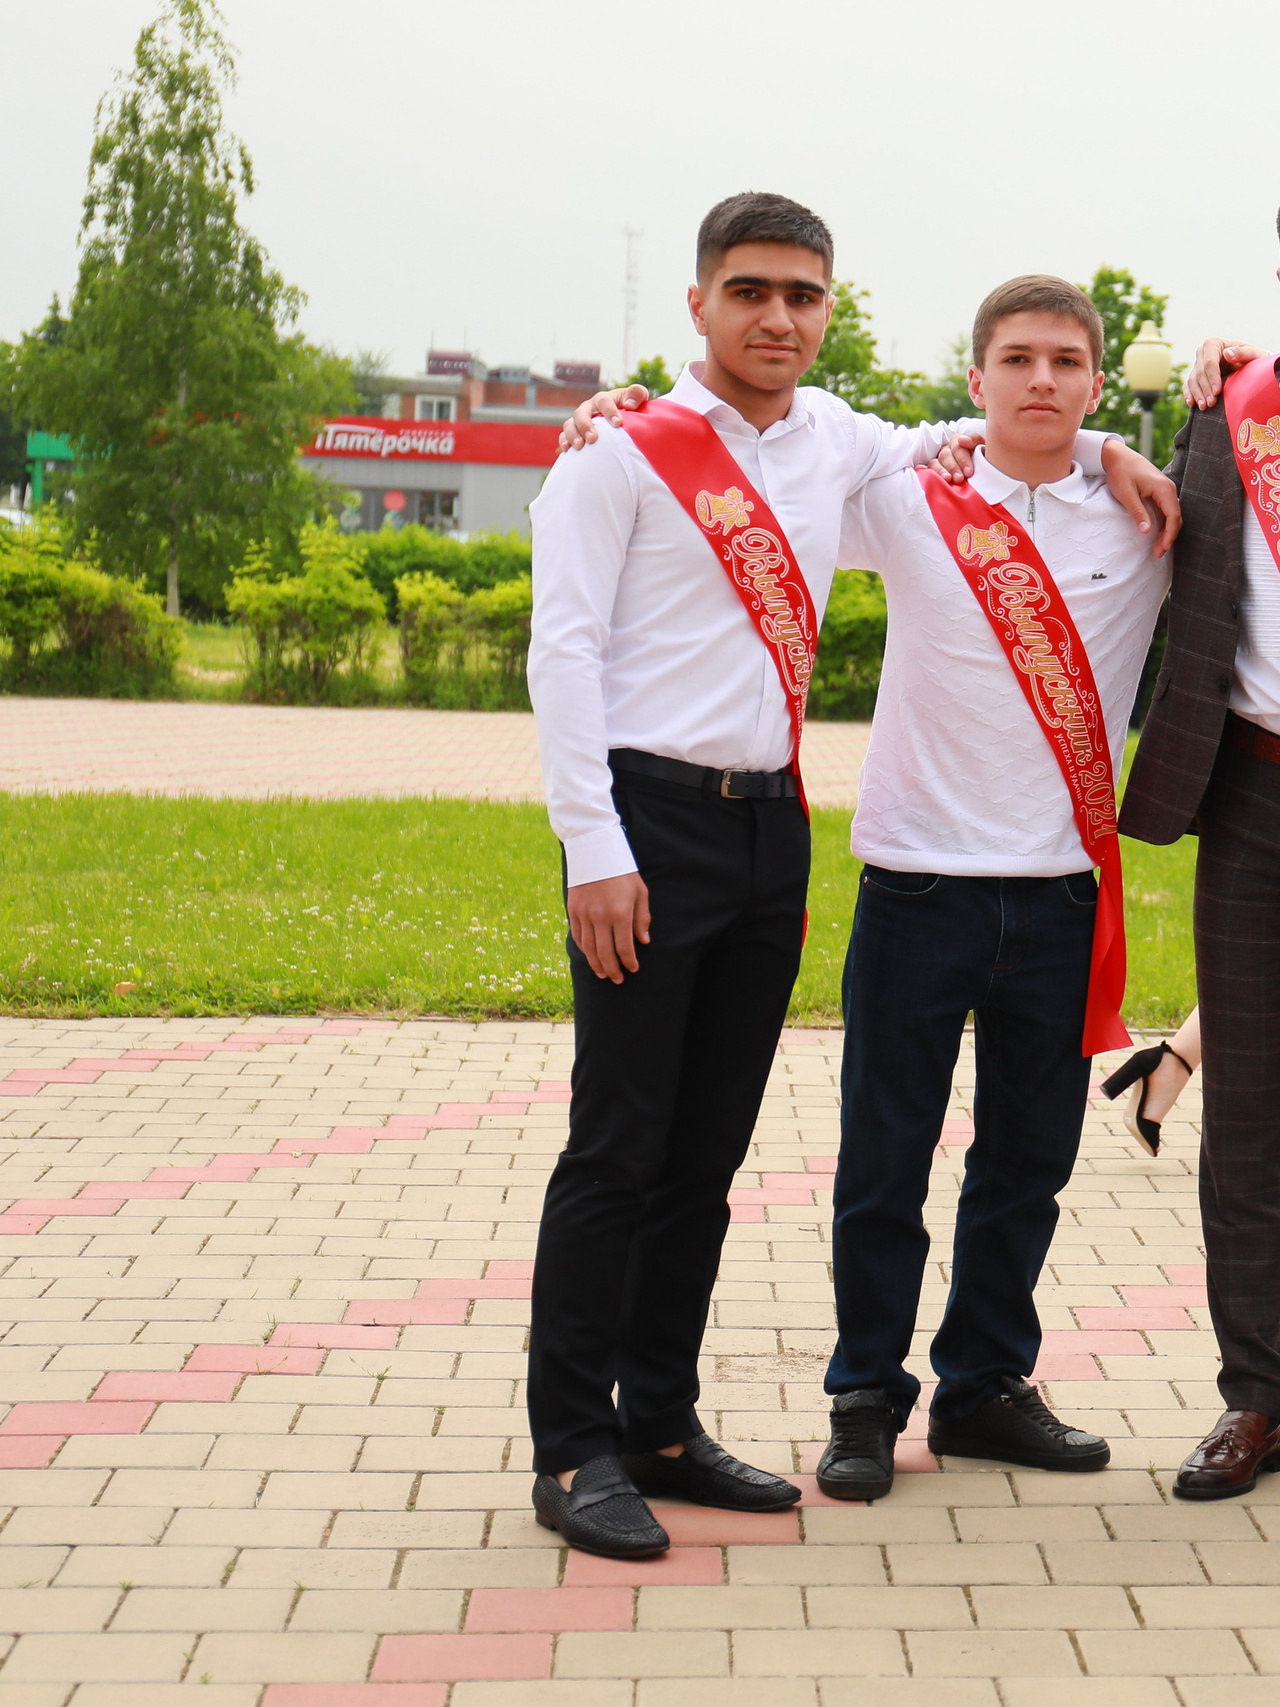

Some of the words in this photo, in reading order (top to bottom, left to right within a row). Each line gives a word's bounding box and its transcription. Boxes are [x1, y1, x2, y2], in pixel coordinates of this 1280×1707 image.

[988, 561, 1094, 767] Выпускник
[1078, 760, 1118, 840] 2021
[1054, 732, 1072, 766] УСПЕХА
